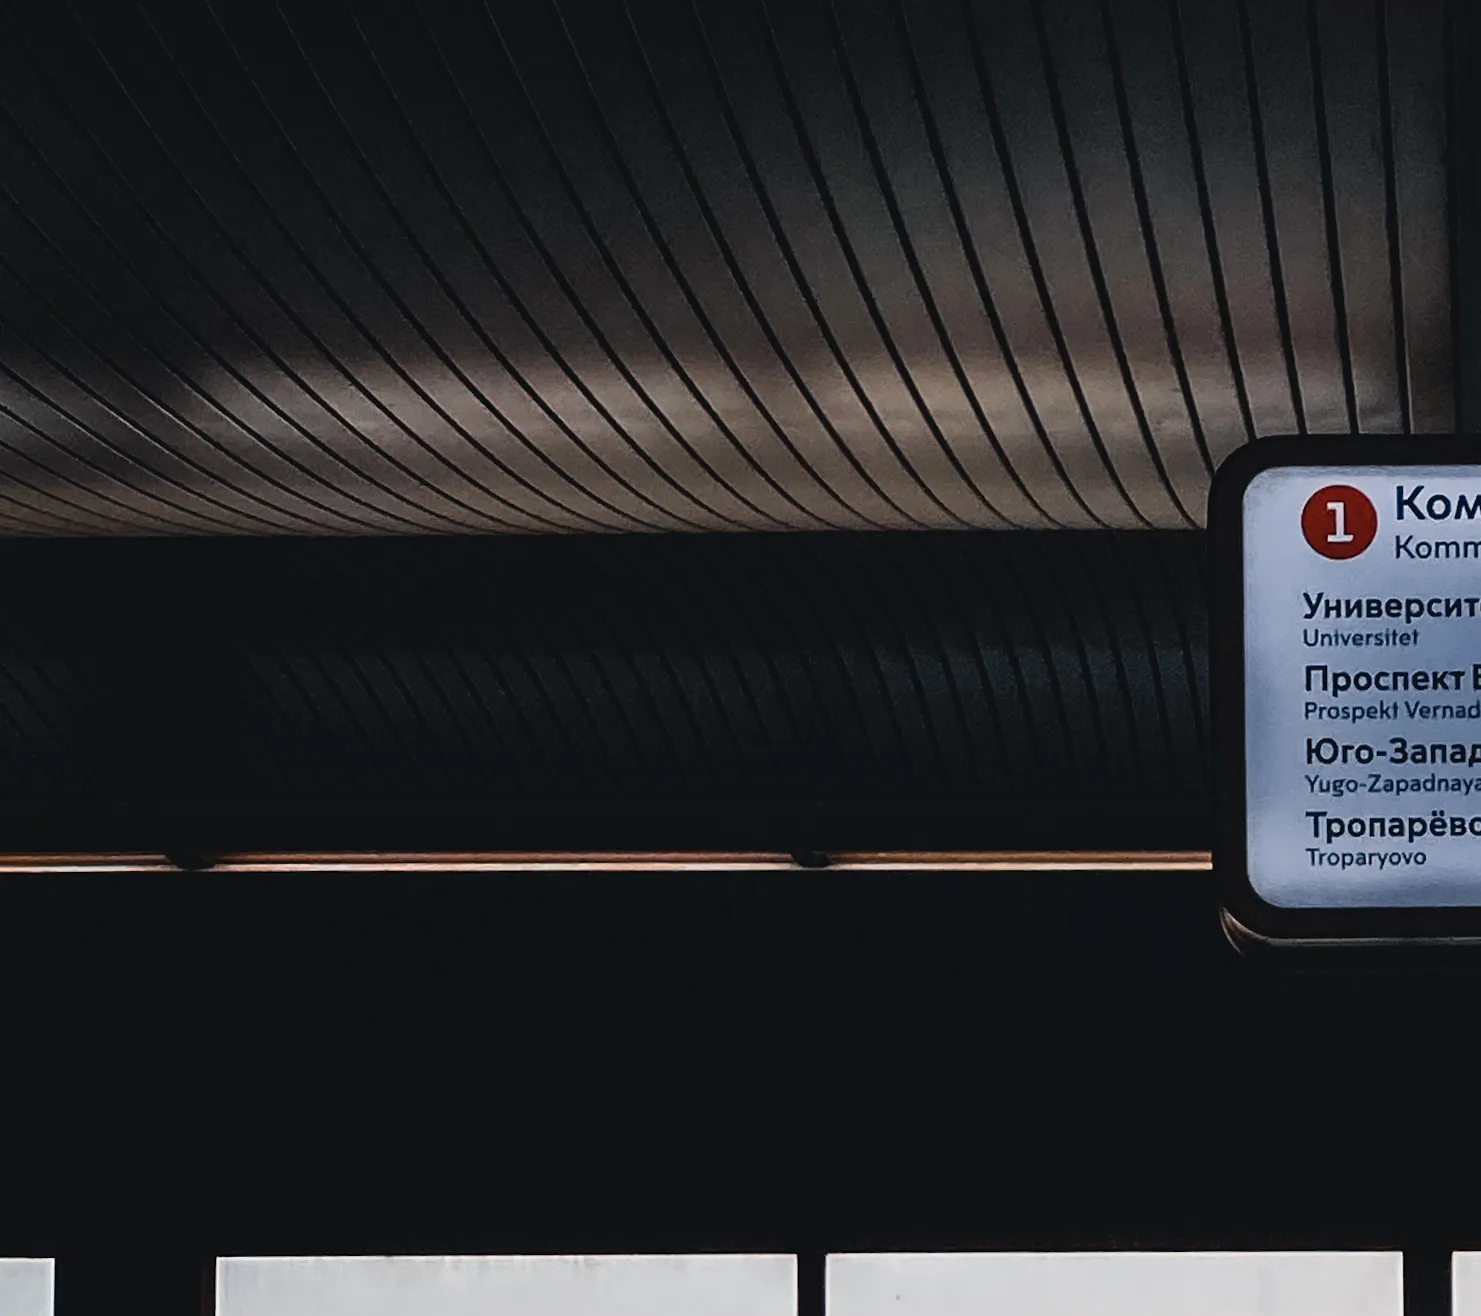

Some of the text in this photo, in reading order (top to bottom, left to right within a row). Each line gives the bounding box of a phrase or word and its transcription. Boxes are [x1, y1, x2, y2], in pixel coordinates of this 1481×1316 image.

[1326, 500, 1355, 544] 1
[1303, 627, 1419, 647] Universitet
[1305, 664, 1466, 698] Проспект
[1304, 699, 1399, 724] Prospekt
[1305, 847, 1427, 871] Troparyovo
